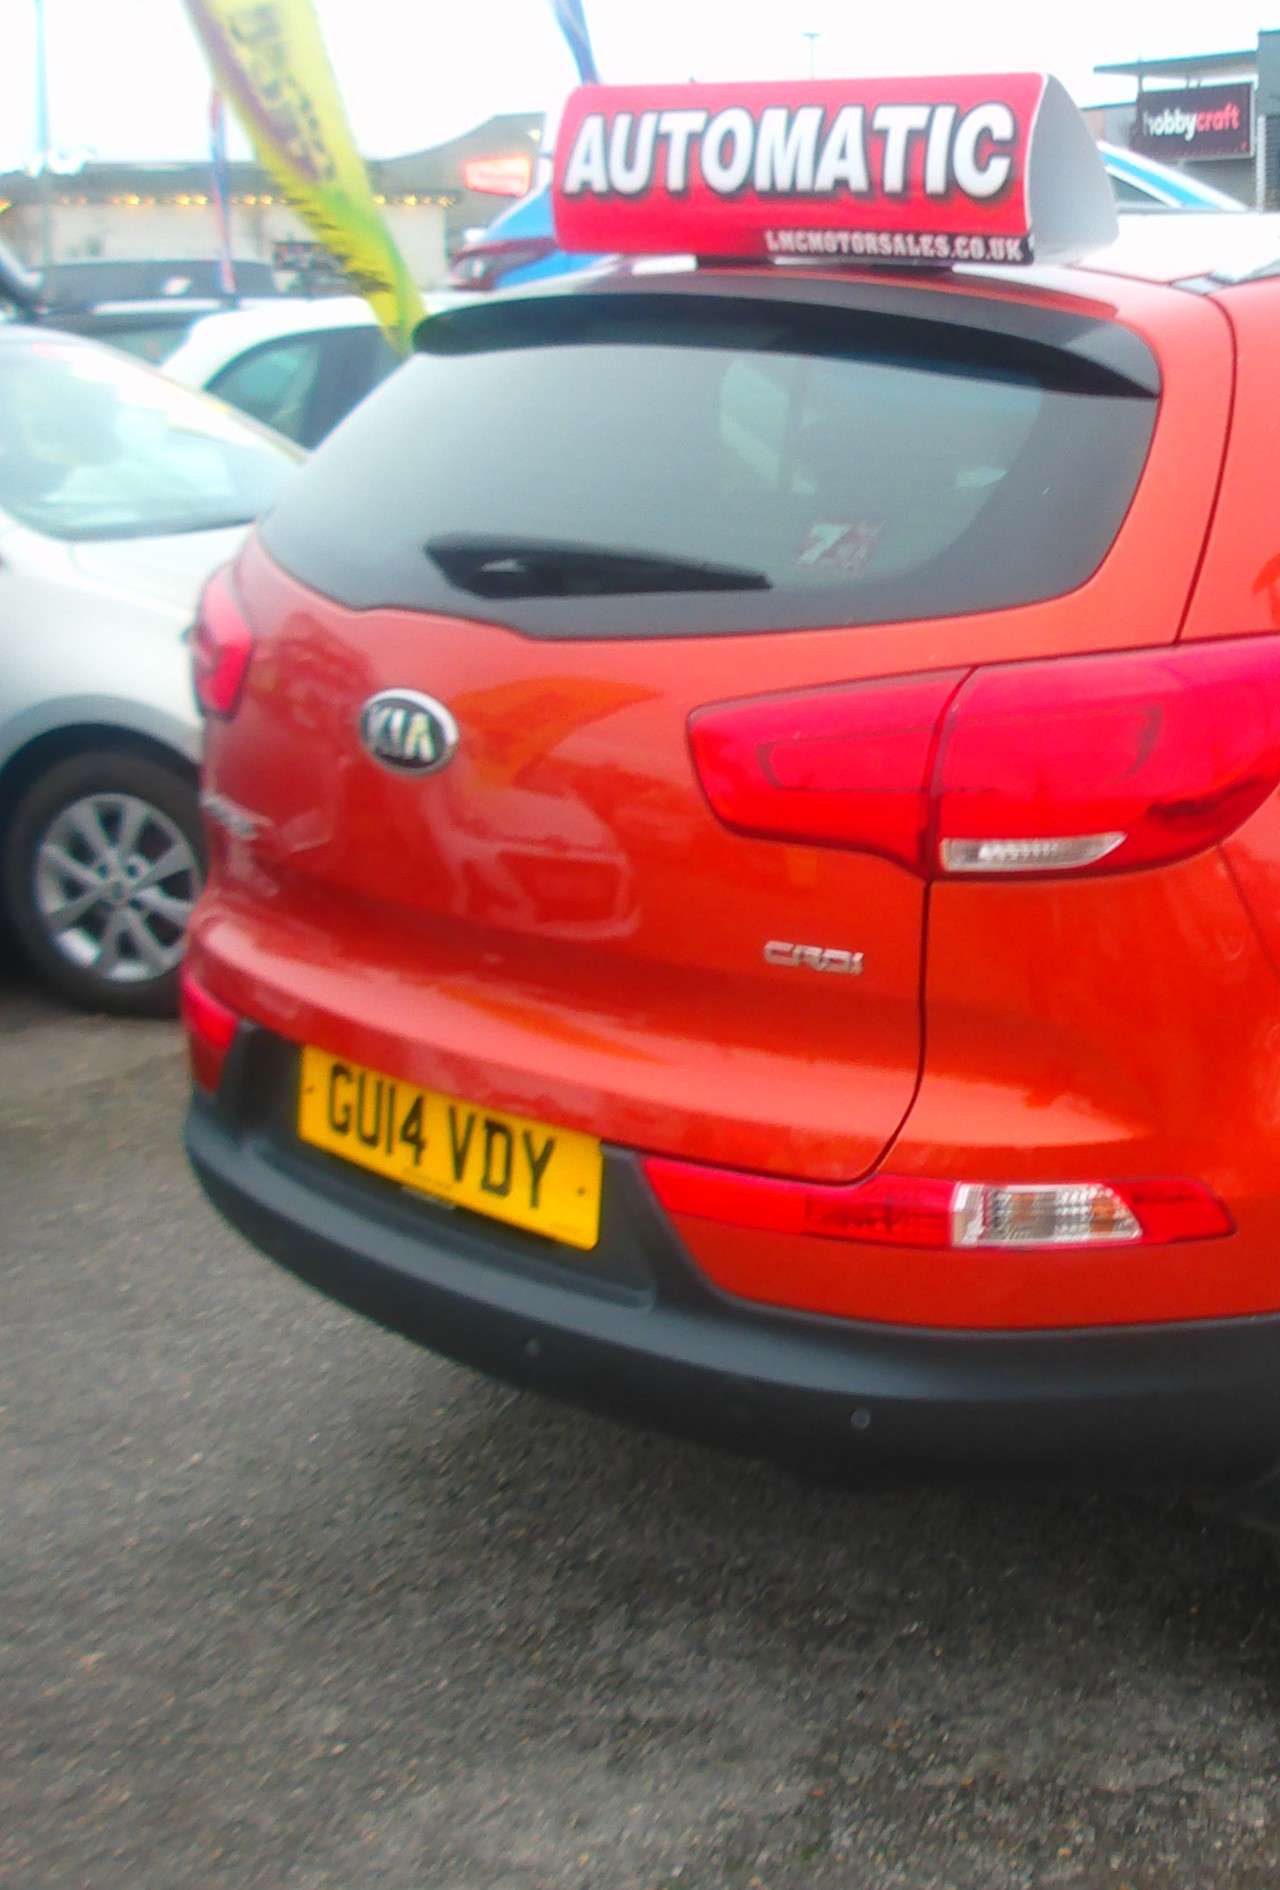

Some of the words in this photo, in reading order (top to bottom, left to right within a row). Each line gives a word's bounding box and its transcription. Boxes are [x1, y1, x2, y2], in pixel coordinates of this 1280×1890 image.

[564, 102, 1015, 198] AUTOMATIC
[1143, 102, 1240, 141] hobbycraft
[366, 703, 437, 762] KIA
[328, 1063, 427, 1168] GU14
[449, 1105, 555, 1209] VDY
